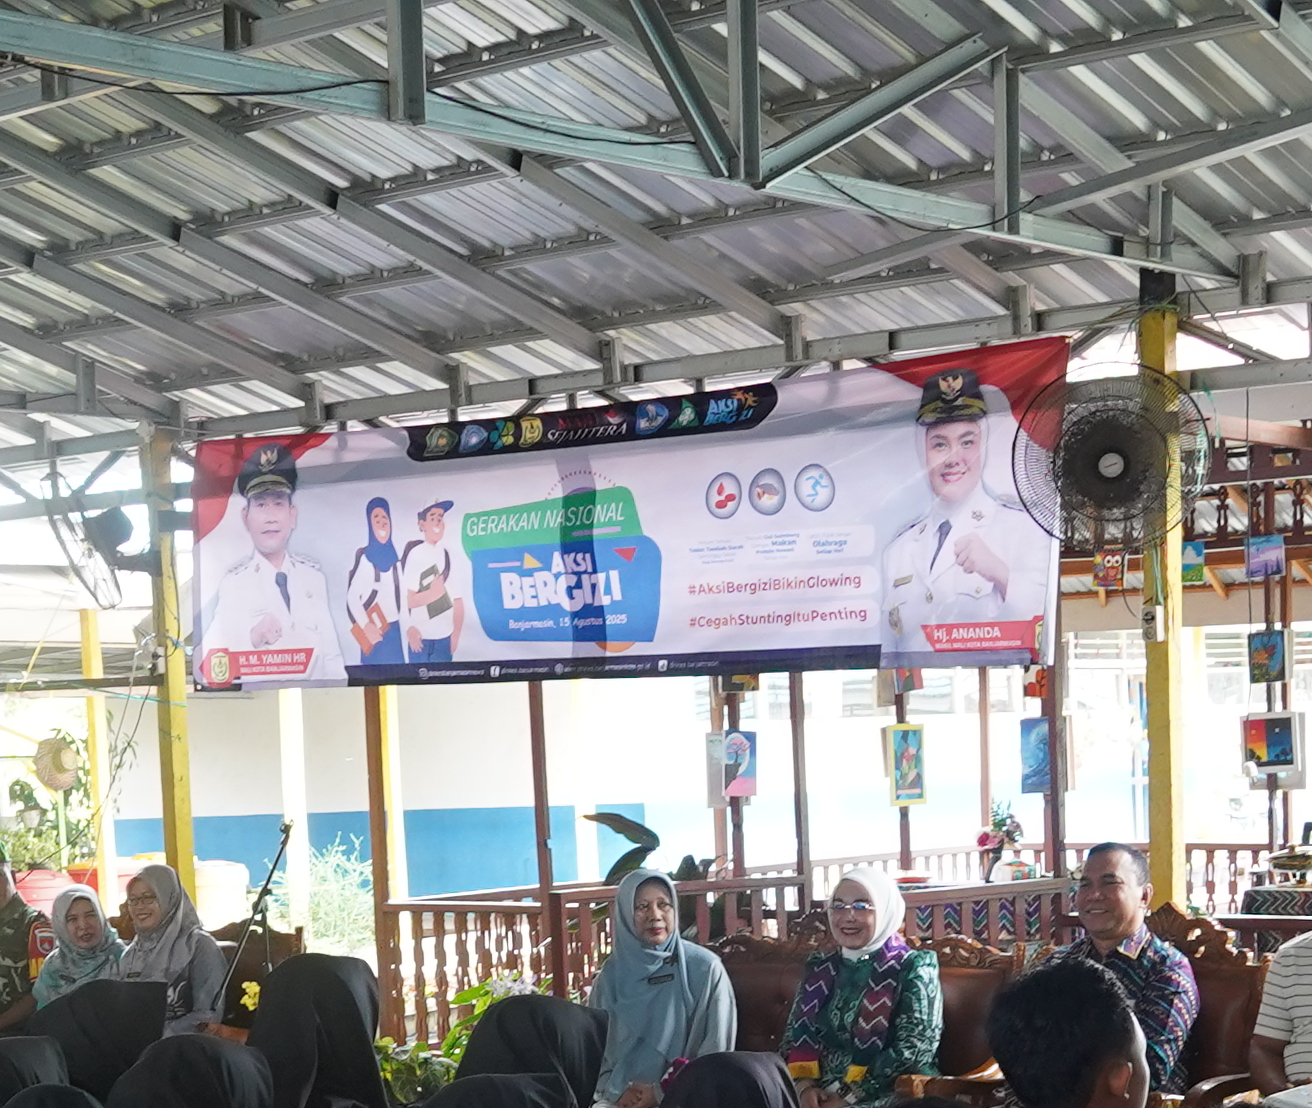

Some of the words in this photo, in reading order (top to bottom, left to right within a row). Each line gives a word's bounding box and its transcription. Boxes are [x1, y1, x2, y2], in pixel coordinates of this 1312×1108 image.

[467, 512, 541, 537] GERAKAN
[543, 501, 626, 528] NASIONAL
[551, 551, 593, 575] AKSI
[499, 569, 623, 612] BERGIZI
[688, 573, 862, 596] #AksiBergiziBikinGlowing
[606, 614, 628, 625] 2025
[689, 607, 868, 629] #CegahStuntingItuPenting
[951, 626, 1002, 640] ANANDA
[261, 653, 292, 664] YAMIN
[293, 652, 307, 663] HR
